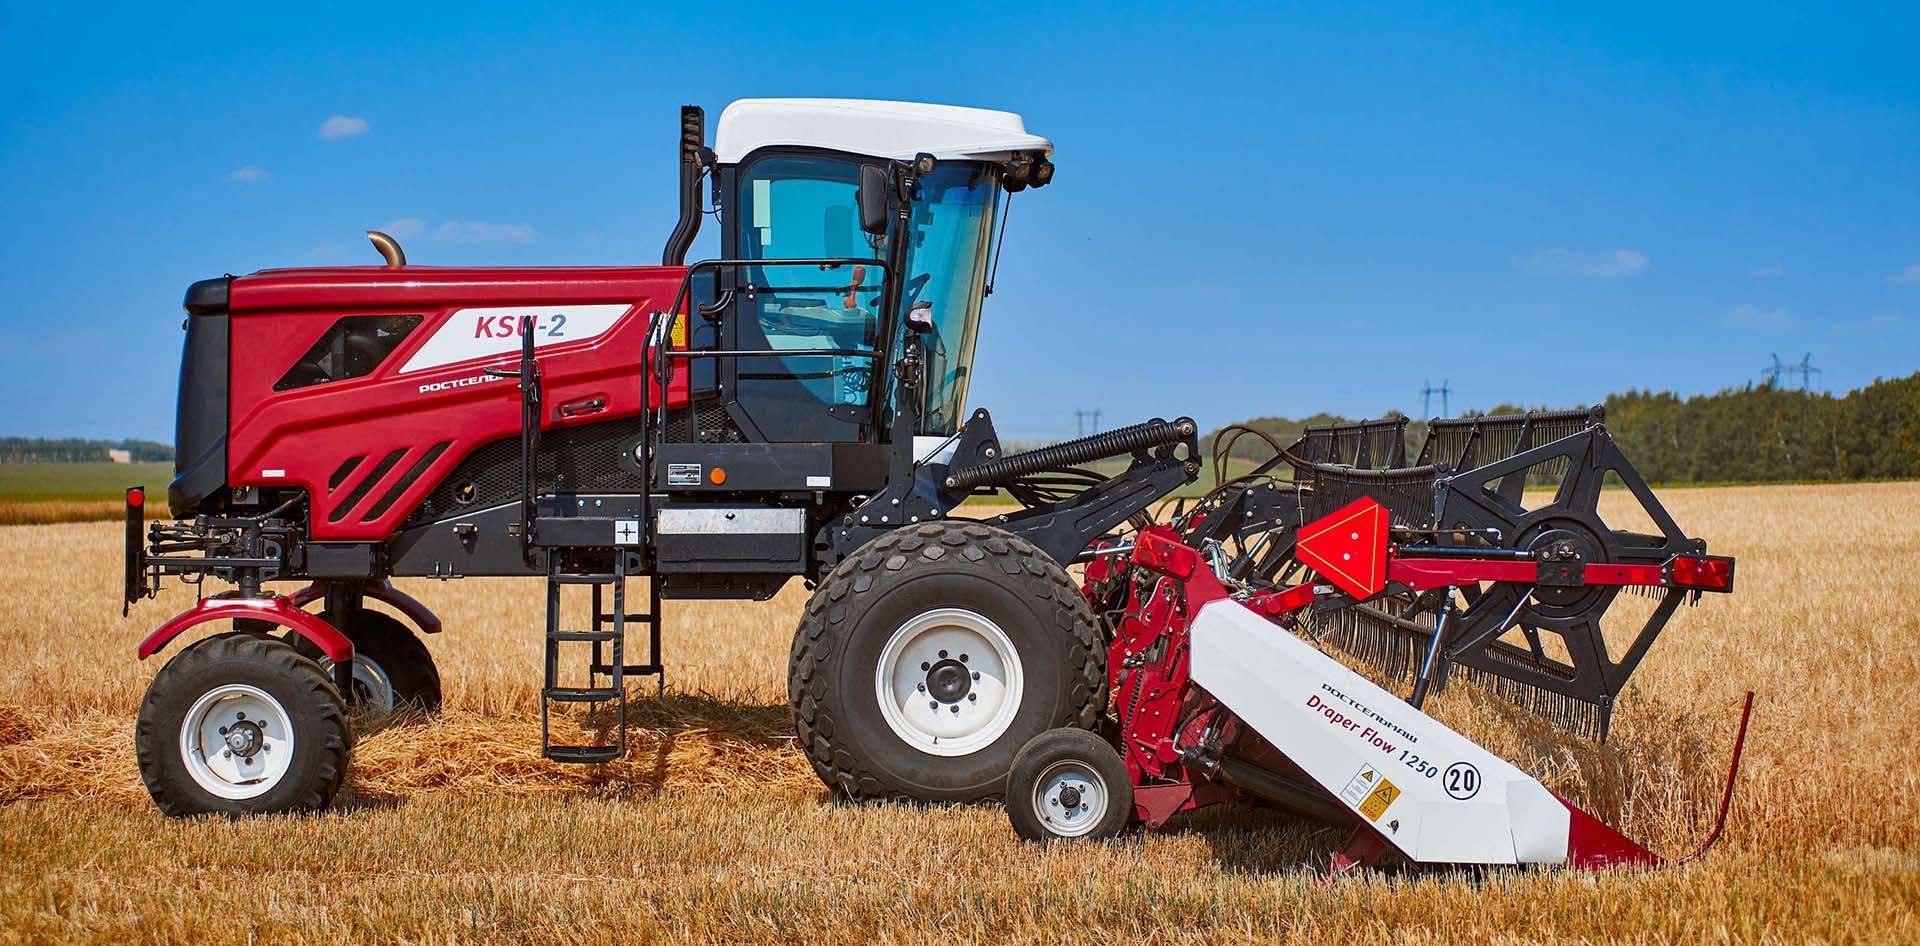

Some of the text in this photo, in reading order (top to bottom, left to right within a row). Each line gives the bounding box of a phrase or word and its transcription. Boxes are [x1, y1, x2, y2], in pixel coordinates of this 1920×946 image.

[475, 314, 567, 338] KSU-2
[419, 375, 503, 393] РОСТСЕЛЬ
[1306, 695, 1438, 779] Draper Flow 1250
[1449, 769, 1475, 792] 20
